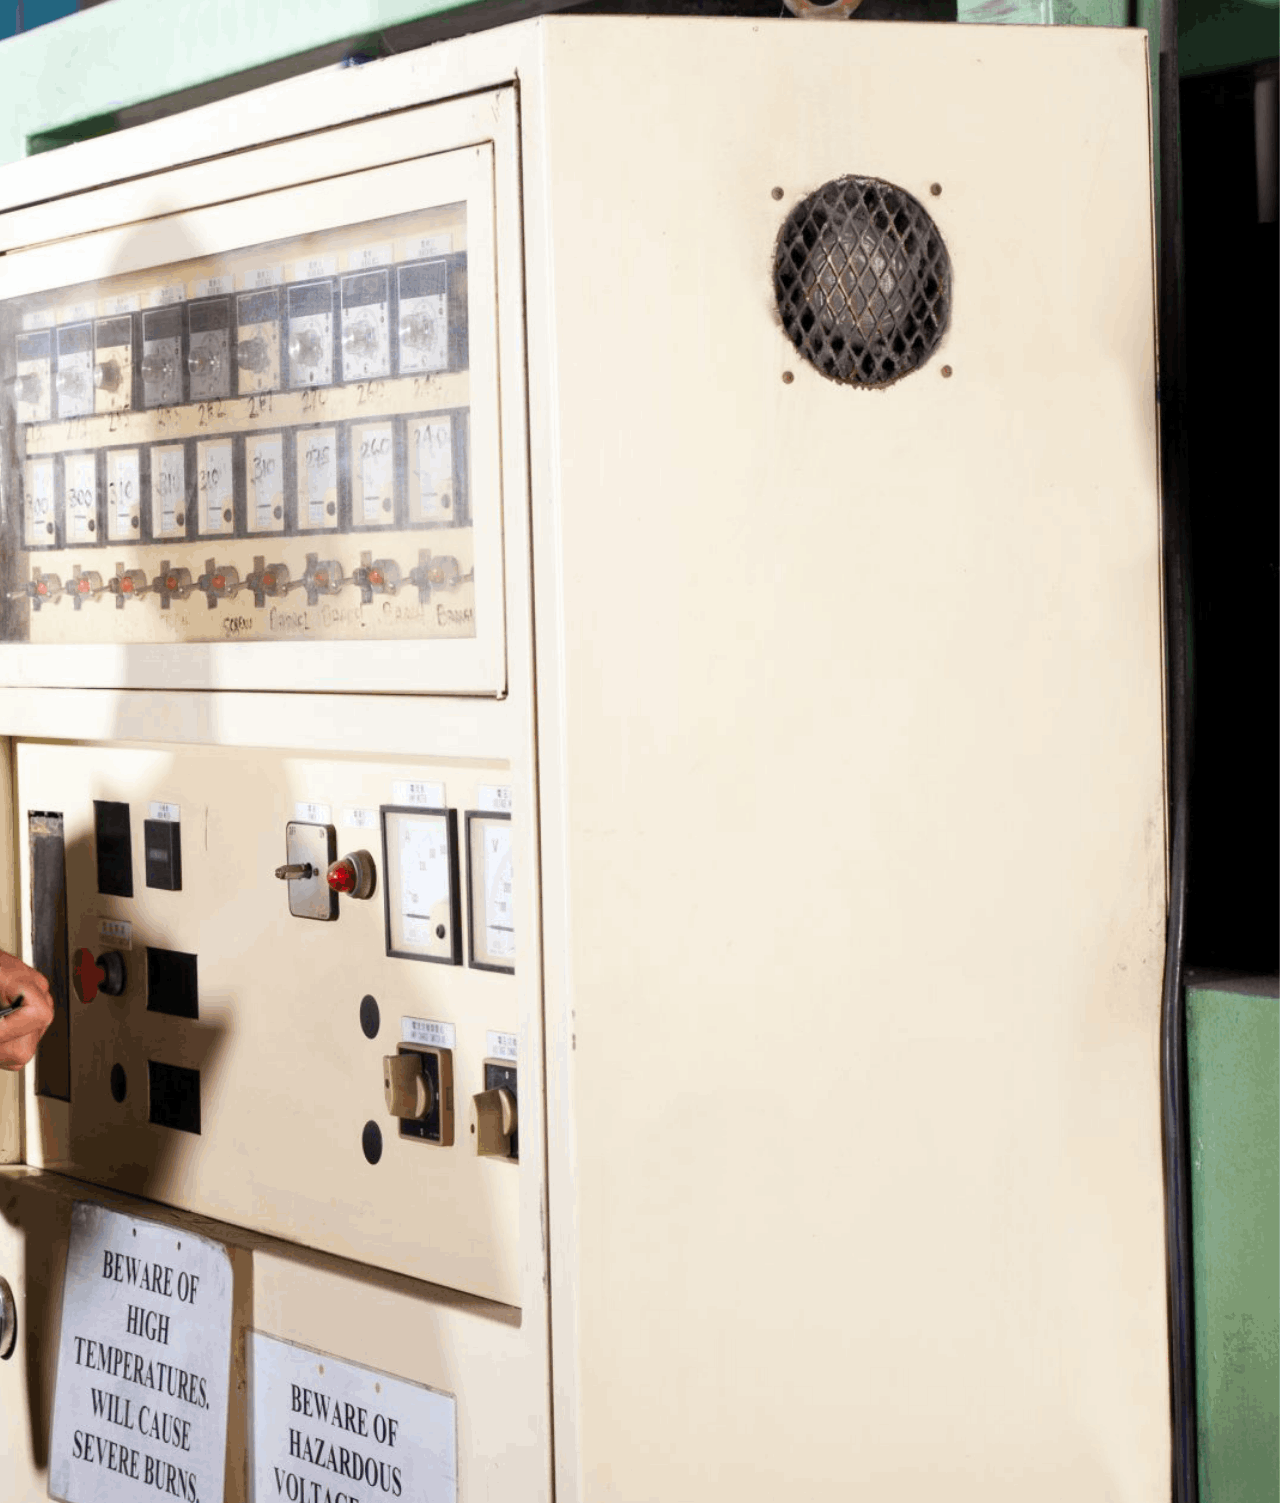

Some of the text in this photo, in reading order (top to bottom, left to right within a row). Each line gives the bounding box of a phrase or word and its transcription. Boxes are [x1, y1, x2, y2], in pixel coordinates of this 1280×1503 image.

[102, 1249, 200, 1304] BEWARE OF
[126, 1303, 170, 1345] HIGH
[74, 1335, 209, 1411] TEMPERATURES.
[91, 1387, 191, 1452] WILL CAUSE
[291, 1383, 399, 1447] BEWARE OF
[72, 1429, 140, 1481] SEVERE
[274, 1466, 360, 1503] VOLTA
[289, 1427, 402, 1498] HAZARDOUS
